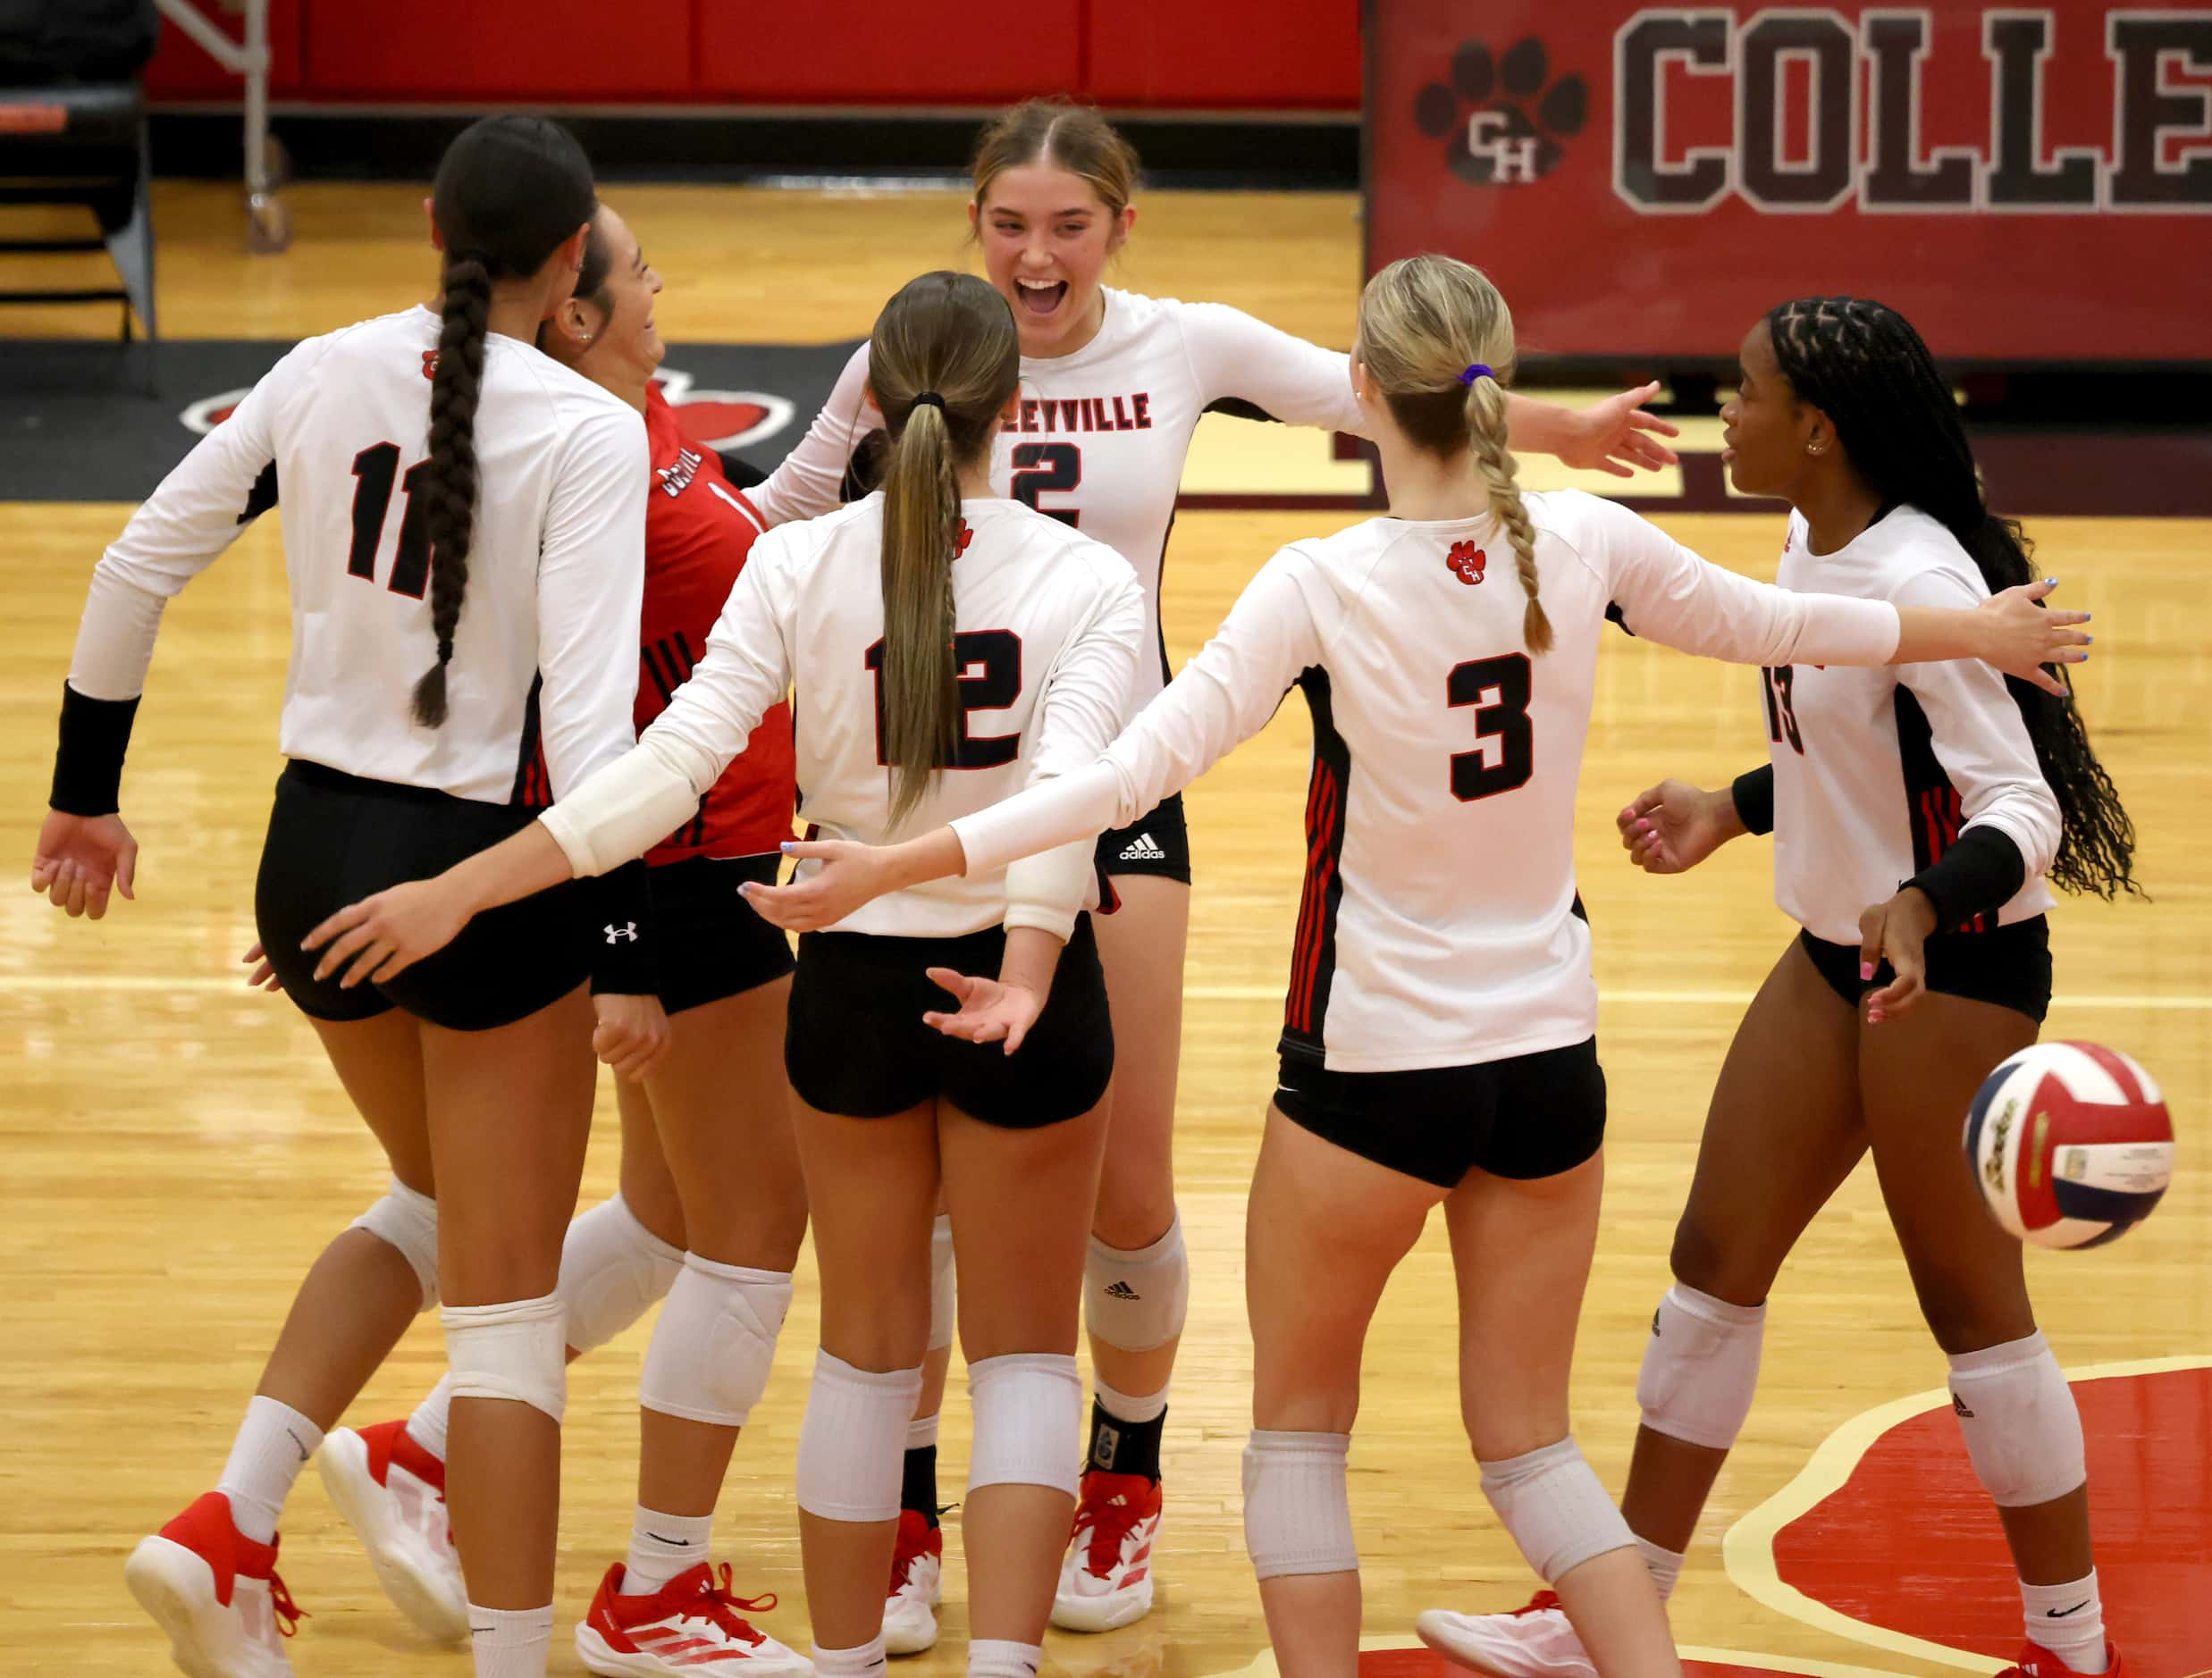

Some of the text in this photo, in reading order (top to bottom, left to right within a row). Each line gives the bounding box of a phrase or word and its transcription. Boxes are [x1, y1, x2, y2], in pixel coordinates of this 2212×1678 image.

[1468, 110, 1537, 184] CH
[347, 440, 435, 601] 11
[1011, 442, 1081, 529] 2
[1446, 650, 1534, 802] 3
[1761, 664, 1804, 757] 13
[1119, 849, 1165, 860] adidas
